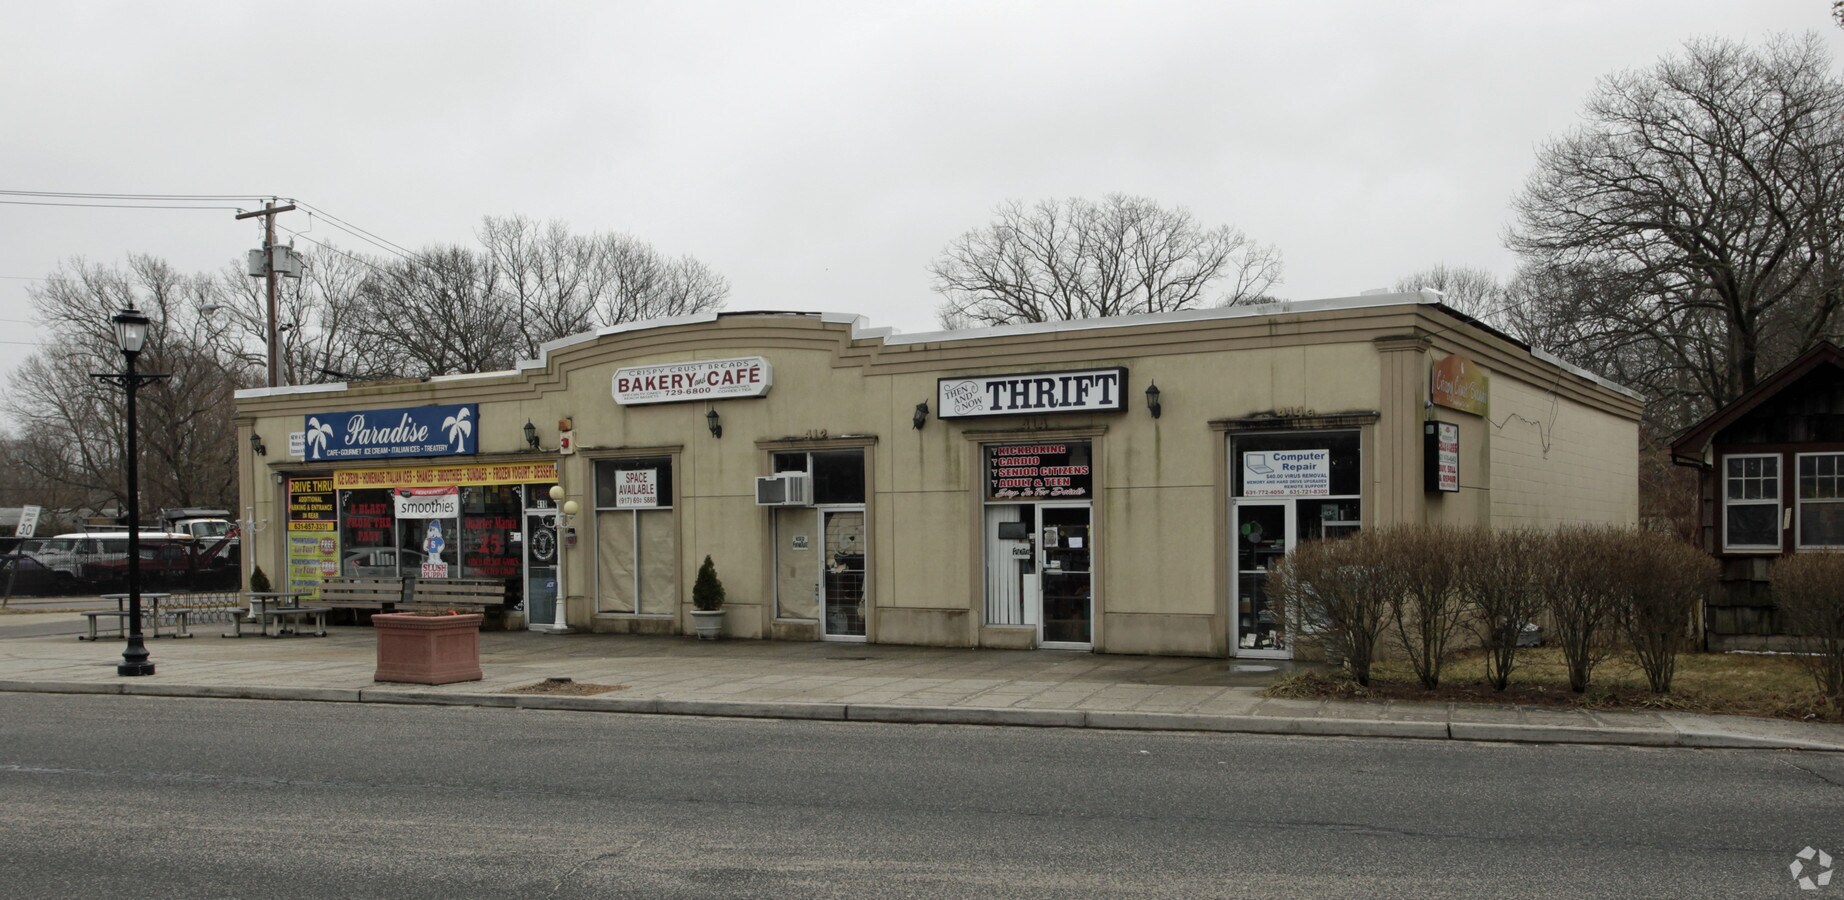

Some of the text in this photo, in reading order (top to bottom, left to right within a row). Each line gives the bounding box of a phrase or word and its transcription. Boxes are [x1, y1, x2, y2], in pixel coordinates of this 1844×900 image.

[628, 360, 749, 377] CRISPY CRUST BREADS
[618, 364, 760, 393] BAKERY and CAFÉ
[945, 386, 968, 400] THEN
[986, 373, 1117, 411] THRIFT
[954, 393, 974, 406] AND
[962, 396, 983, 411] NOW
[344, 412, 429, 446] Paradise
[424, 444, 448, 452] TREATERY
[998, 456, 1040, 466] CARDIO
[1273, 452, 1325, 462] Computer
[999, 466, 1089, 477] SENIOR CITIZENS
[1282, 462, 1317, 472] Repair
[626, 472, 647, 484] SPACE
[998, 478, 1032, 487] ADULT
[1044, 476, 1070, 486] TEEN
[291, 480, 333, 493] DRIVE THRU
[618, 484, 654, 495] AVAILABLE
[401, 499, 454, 513] smoothies
[619, 496, 632, 505] (917)
[19, 523, 33, 535] 30
